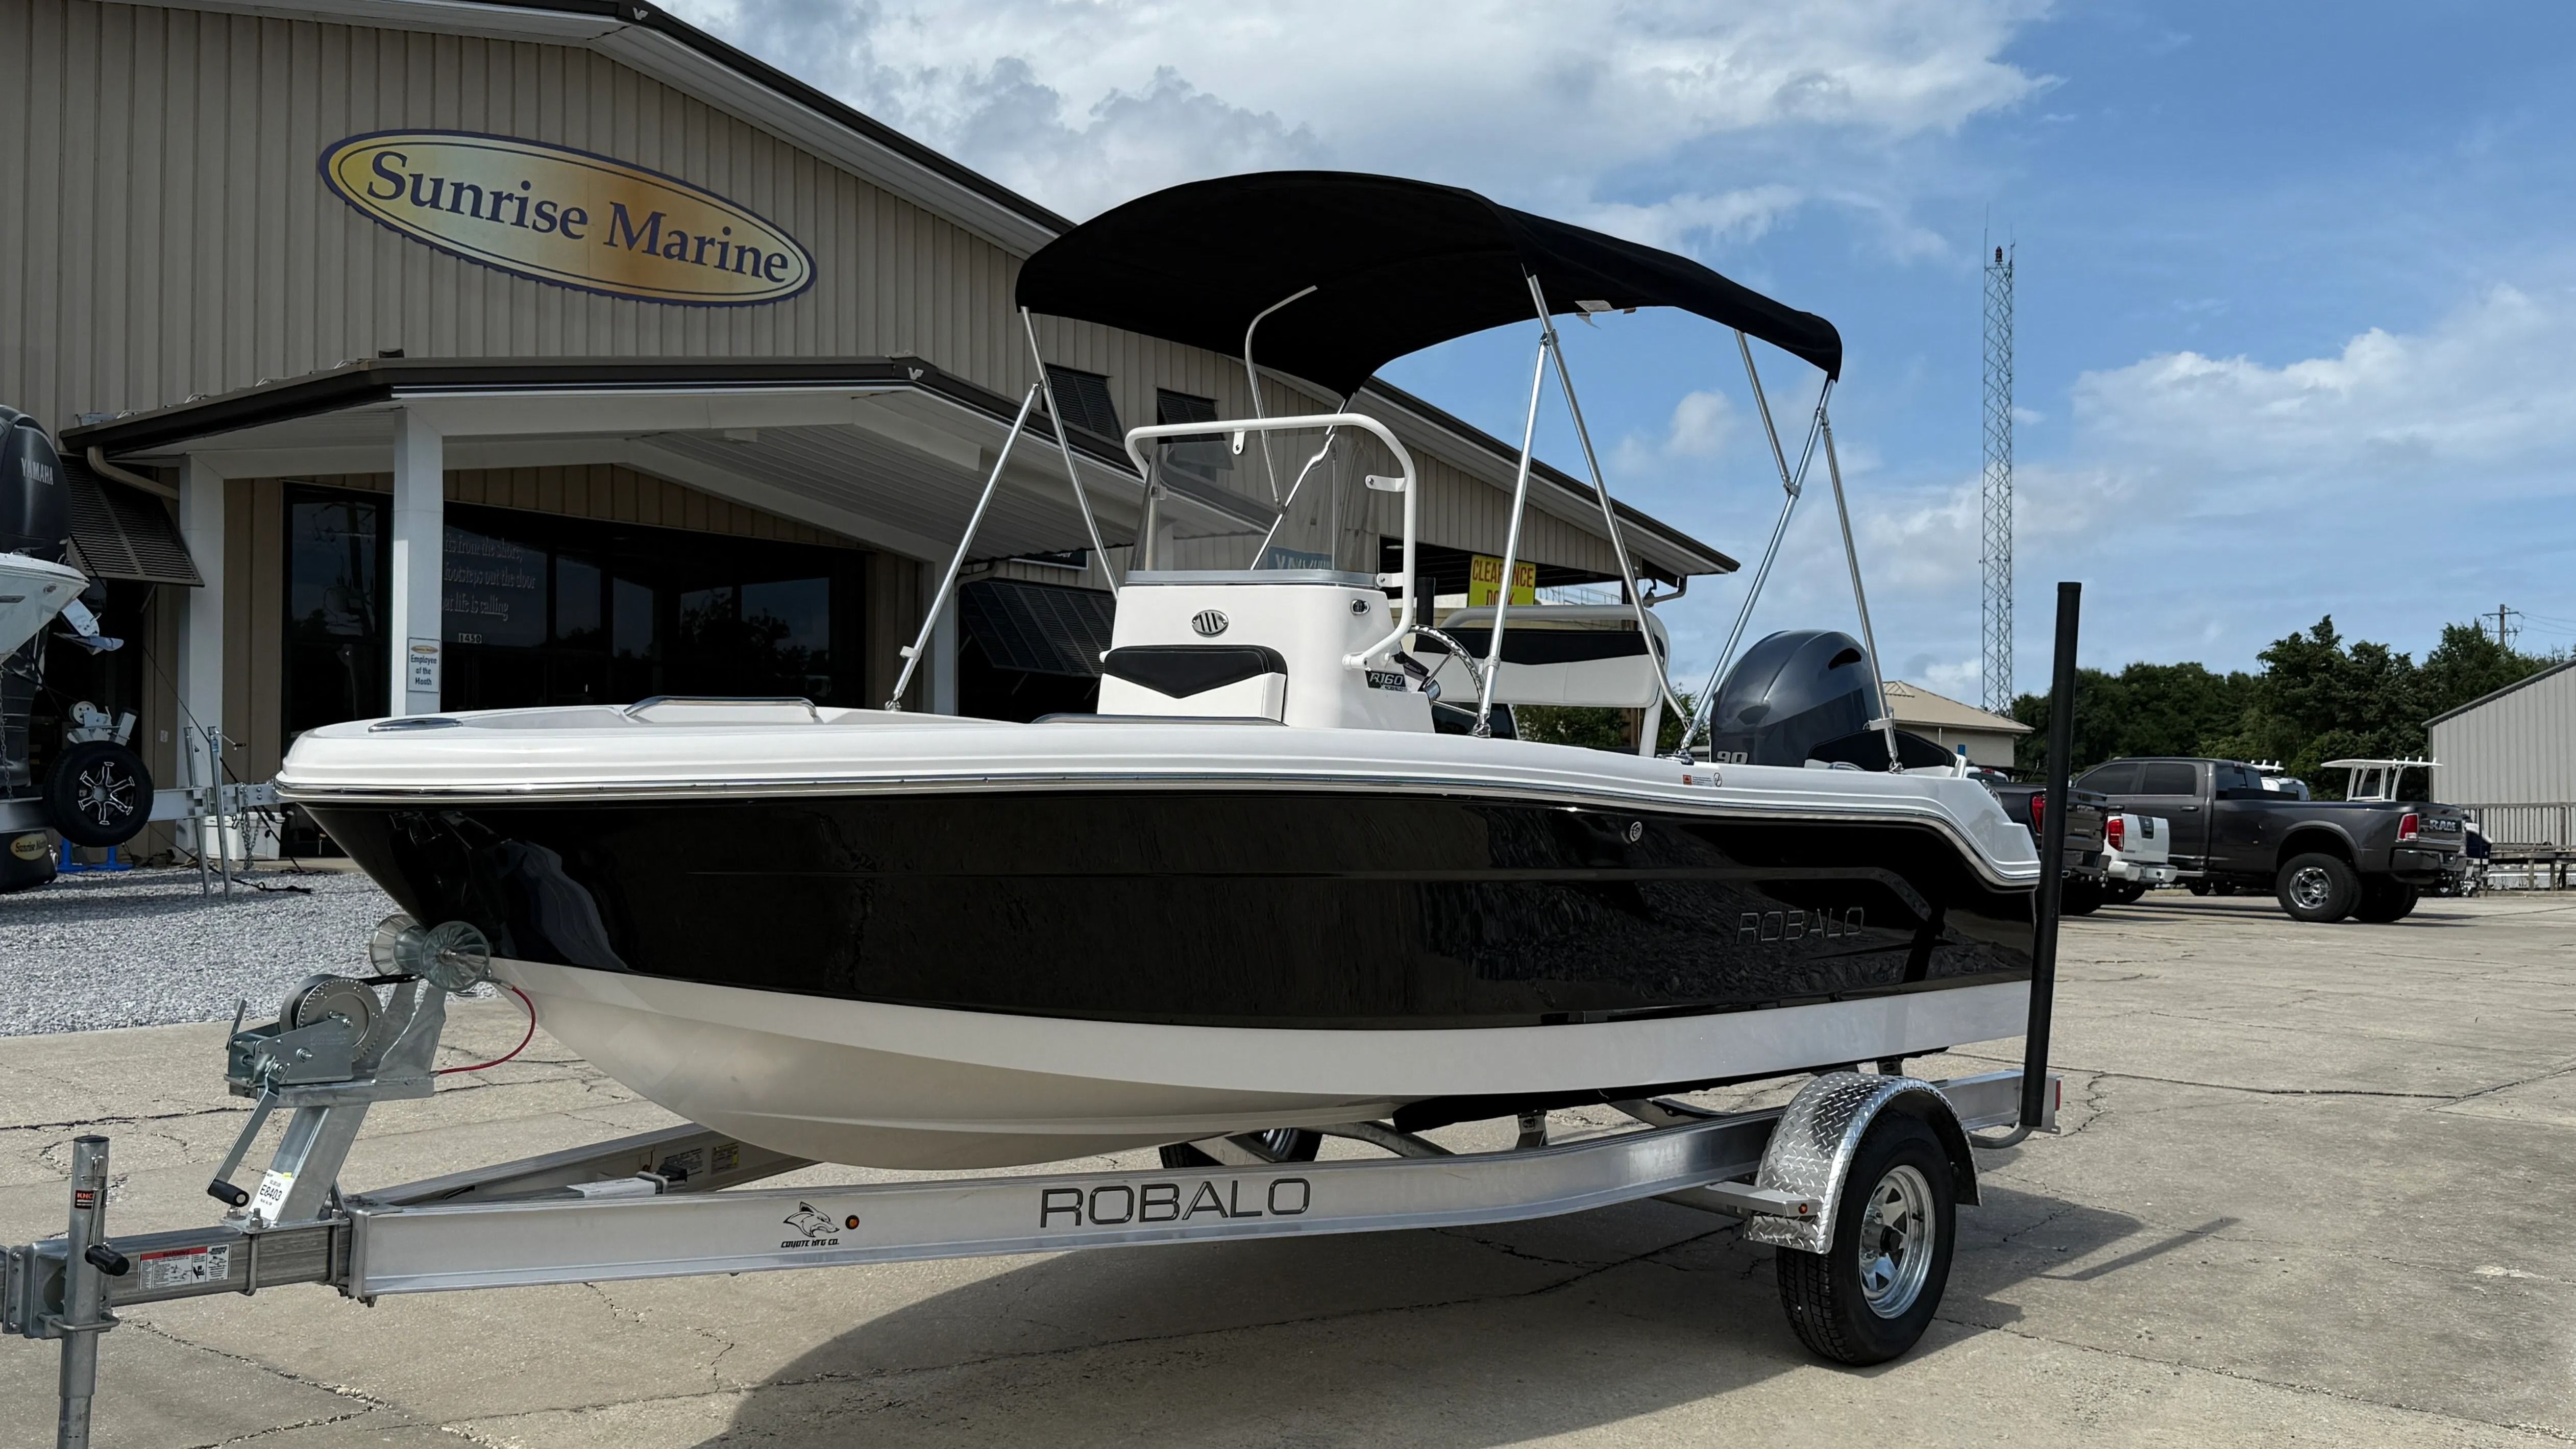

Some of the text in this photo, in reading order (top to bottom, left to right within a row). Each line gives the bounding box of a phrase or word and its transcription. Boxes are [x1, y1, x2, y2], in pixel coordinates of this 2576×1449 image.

[366, 151, 790, 284] Sunrise Marine
[21, 457, 54, 485] YAMAHA
[1473, 559, 1534, 587] CLEARNCE
[1486, 590, 1515, 605] DOK
[460, 634, 481, 643] 1450
[411, 654, 437, 666] Employee
[1369, 673, 1404, 685] R160
[1716, 751, 1748, 765] 90
[2429, 819, 2456, 832] RAM
[1736, 907, 1863, 944] ROBALO
[259, 1184, 282, 1201] E8403
[1040, 1177, 1311, 1228] ROBALO
[780, 1240, 810, 1249] COYOTE
